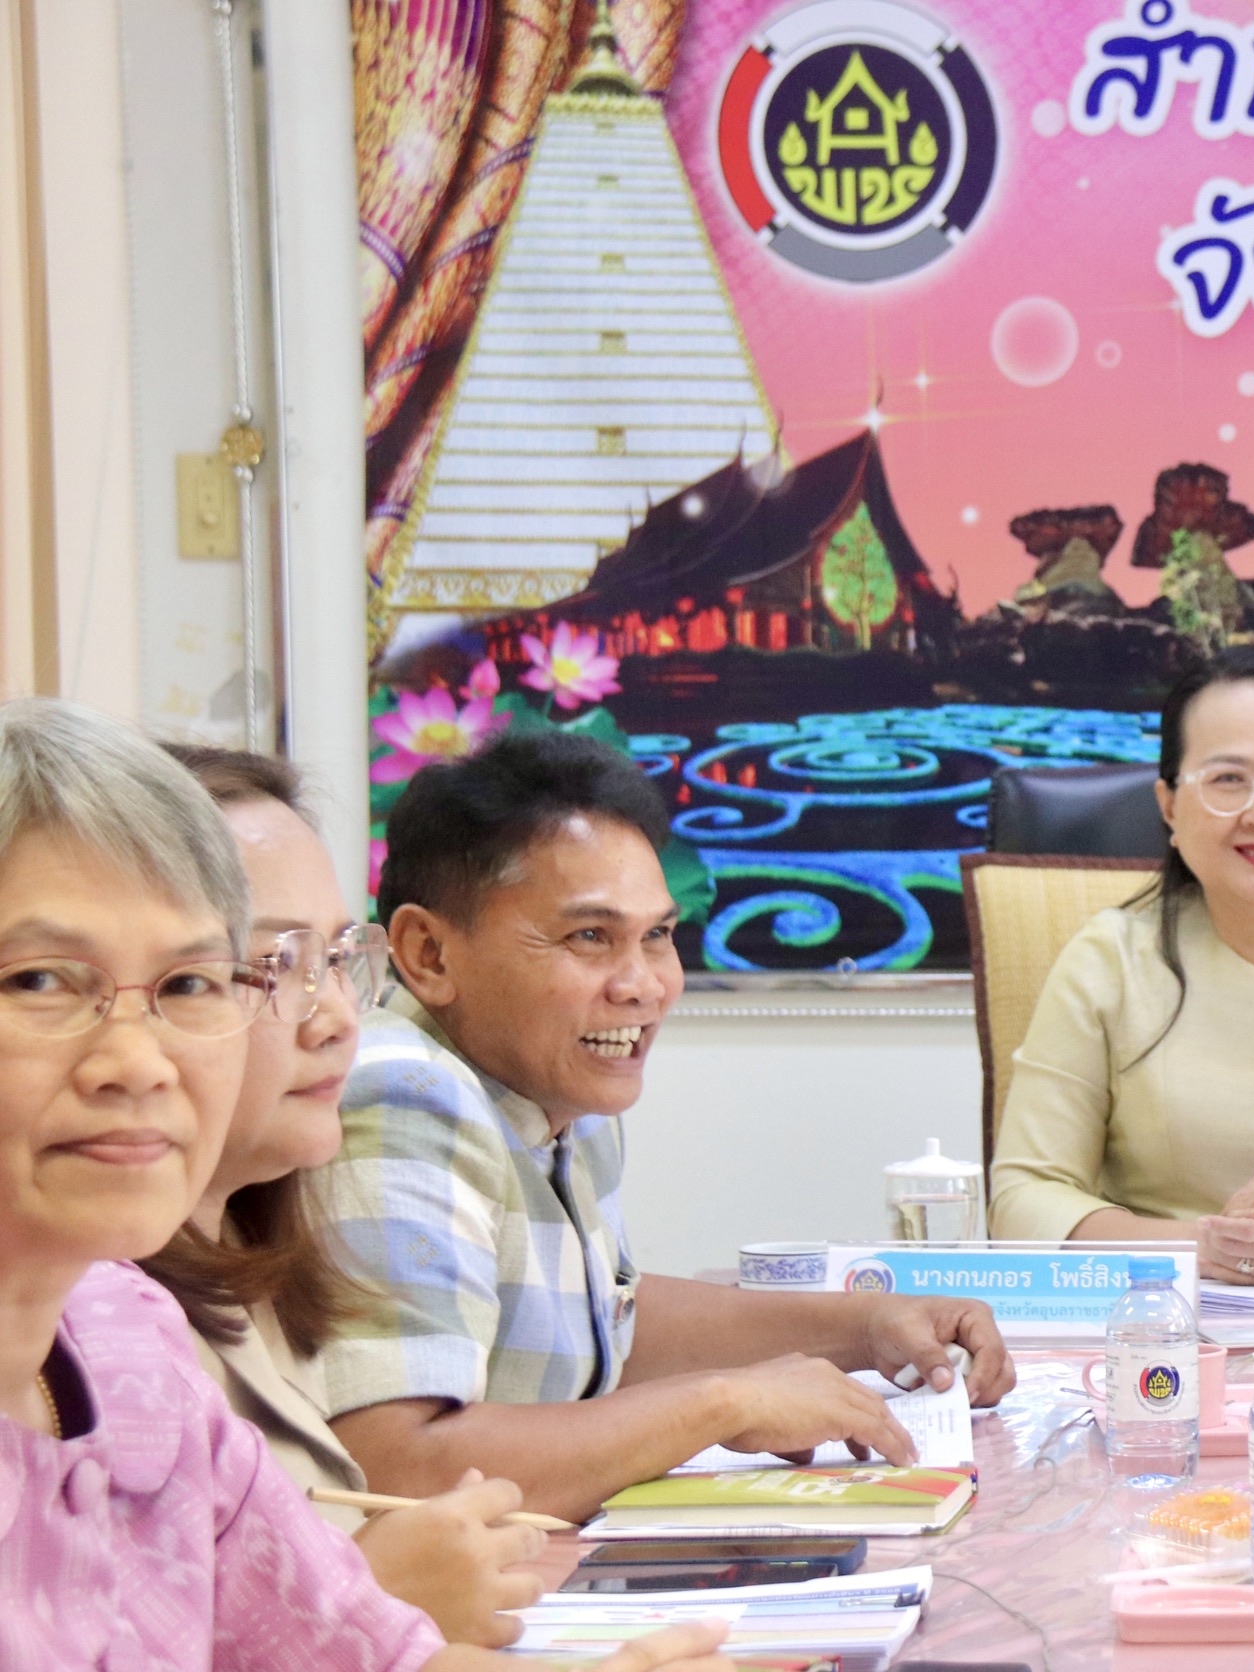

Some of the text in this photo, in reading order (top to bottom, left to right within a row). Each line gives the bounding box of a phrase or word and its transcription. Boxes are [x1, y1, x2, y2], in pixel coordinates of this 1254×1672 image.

[912, 1268, 1032, 1289] นางกนกอร
[993, 1299, 1116, 1320] จังหวัดอุบลราชธา
